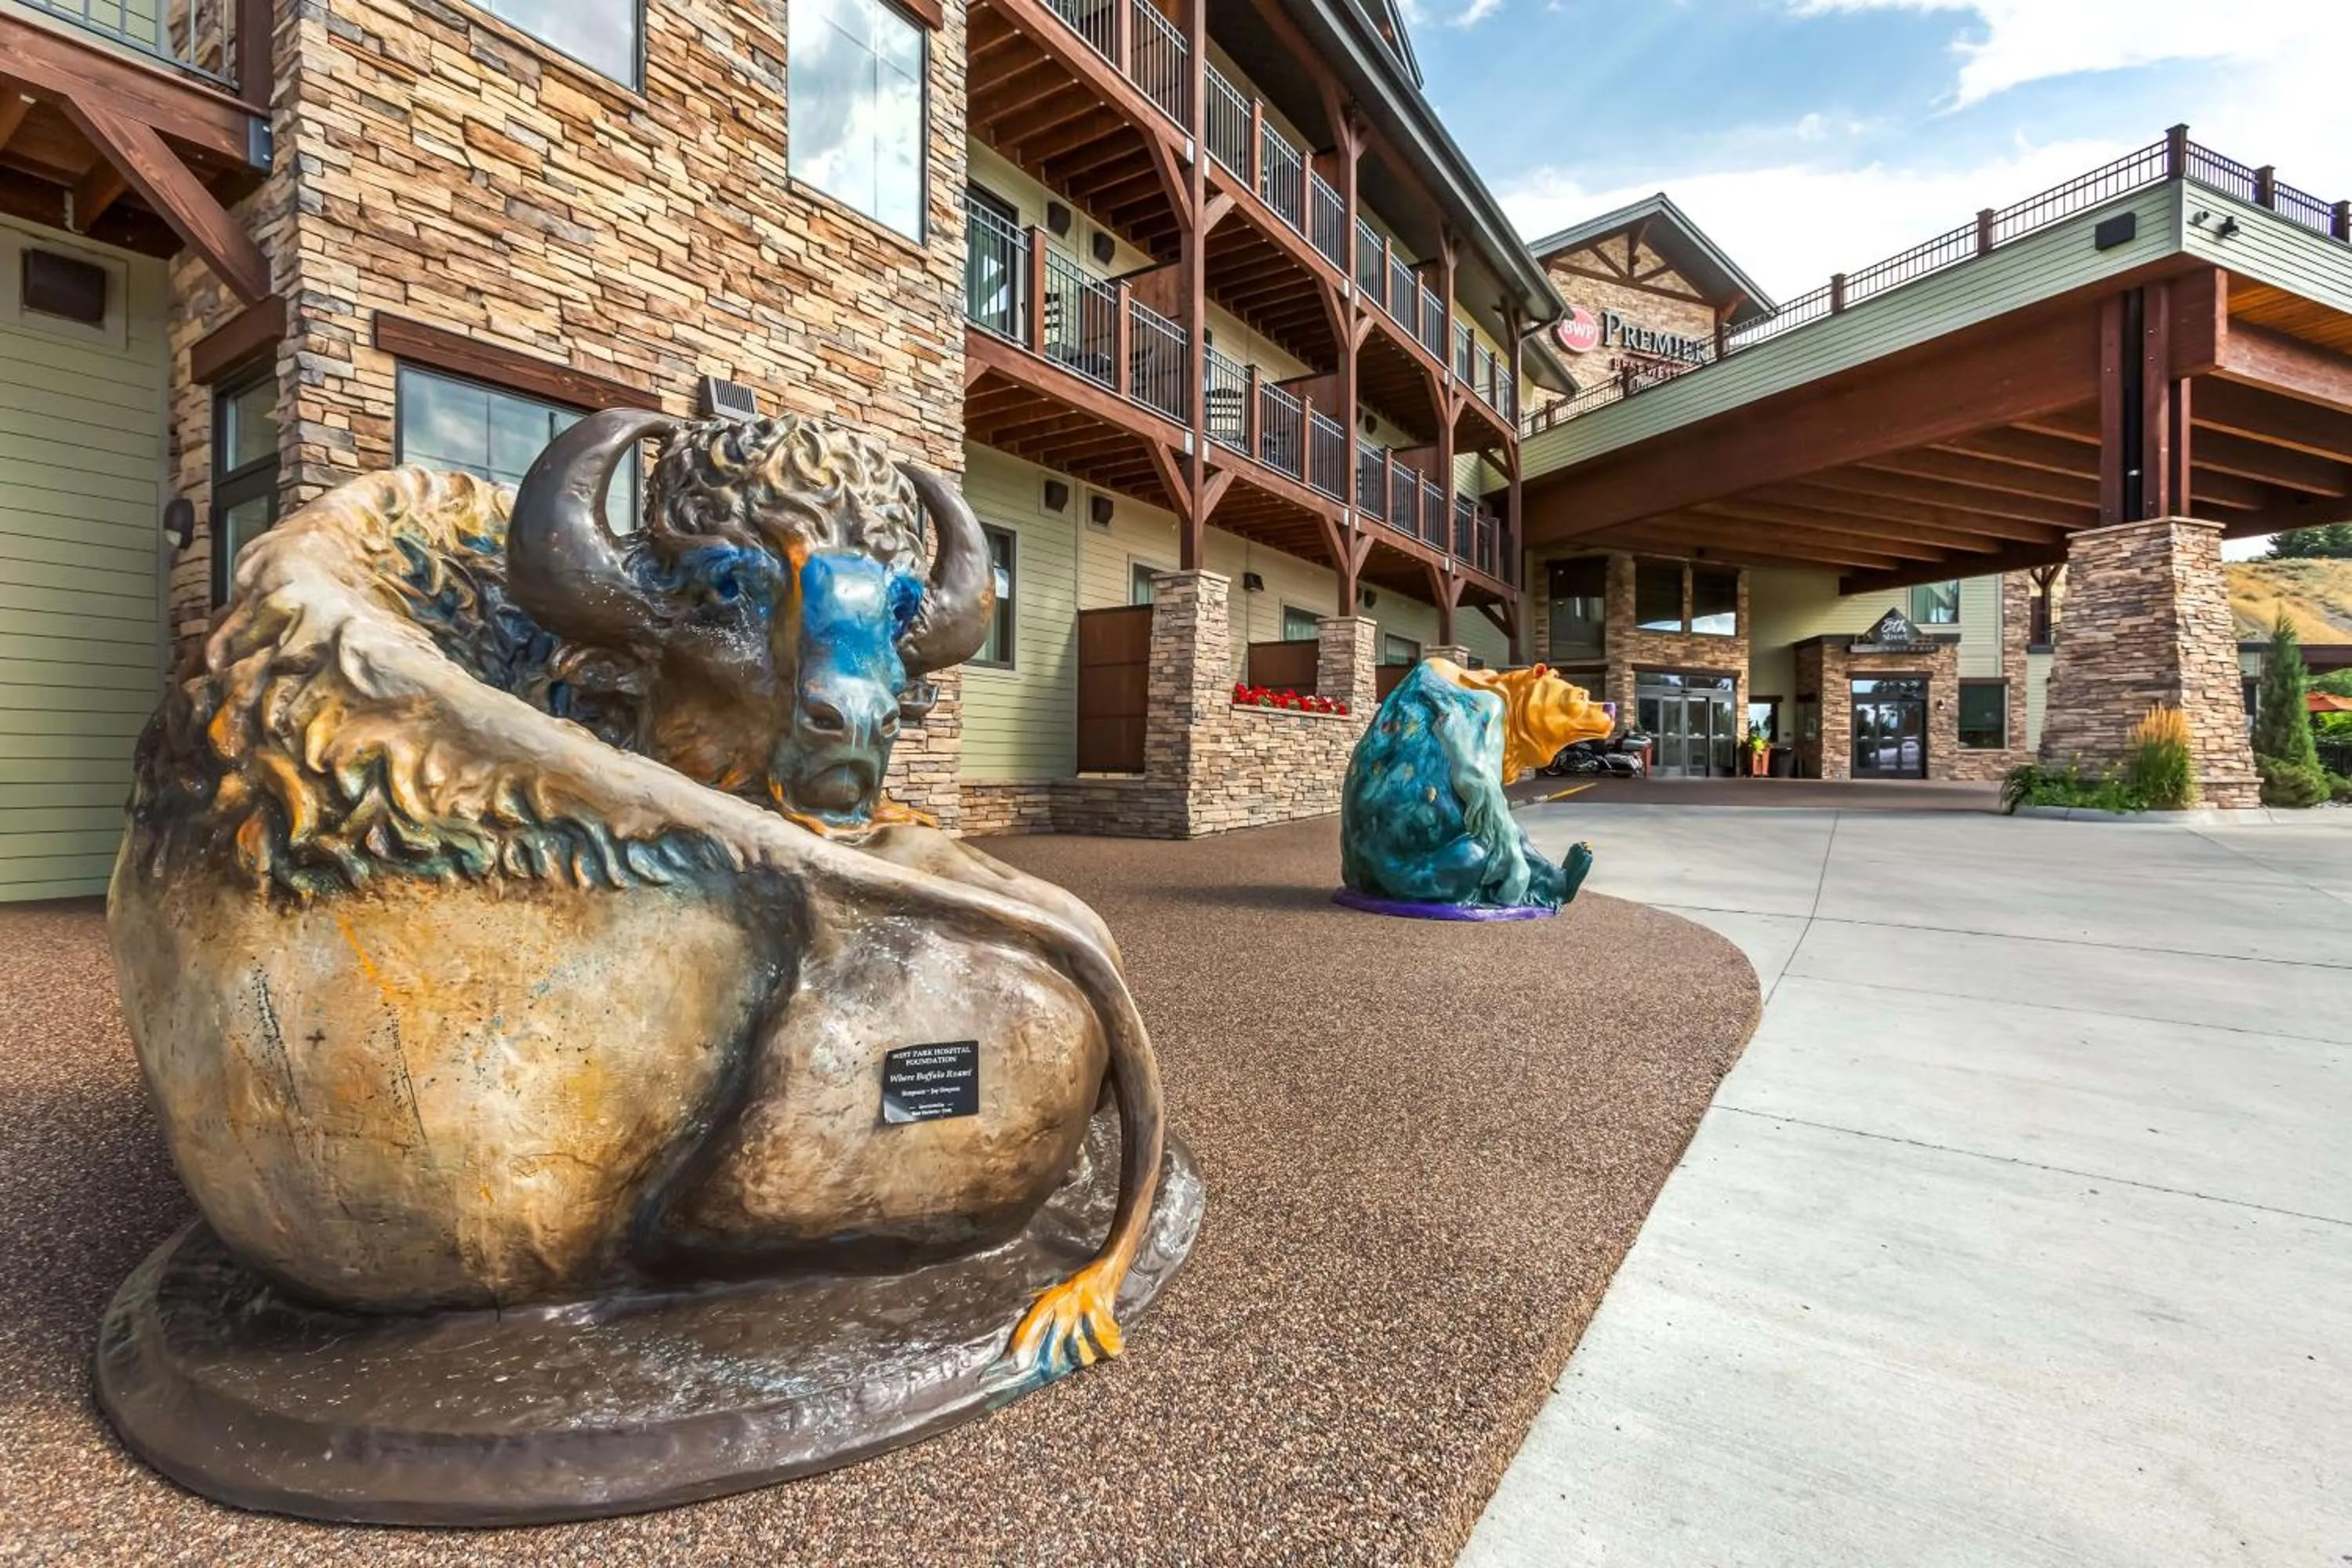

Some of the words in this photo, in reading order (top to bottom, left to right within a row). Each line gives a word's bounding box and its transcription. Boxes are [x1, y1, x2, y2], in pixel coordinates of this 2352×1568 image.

[1564, 321, 1595, 338] BWP
[1605, 310, 1708, 363] PREMIER
[934, 1047, 972, 1055] HOSPITAL
[906, 1055, 957, 1066] FOUNDATION
[890, 1073, 915, 1082] Where
[916, 1071, 946, 1081] Buffalo
